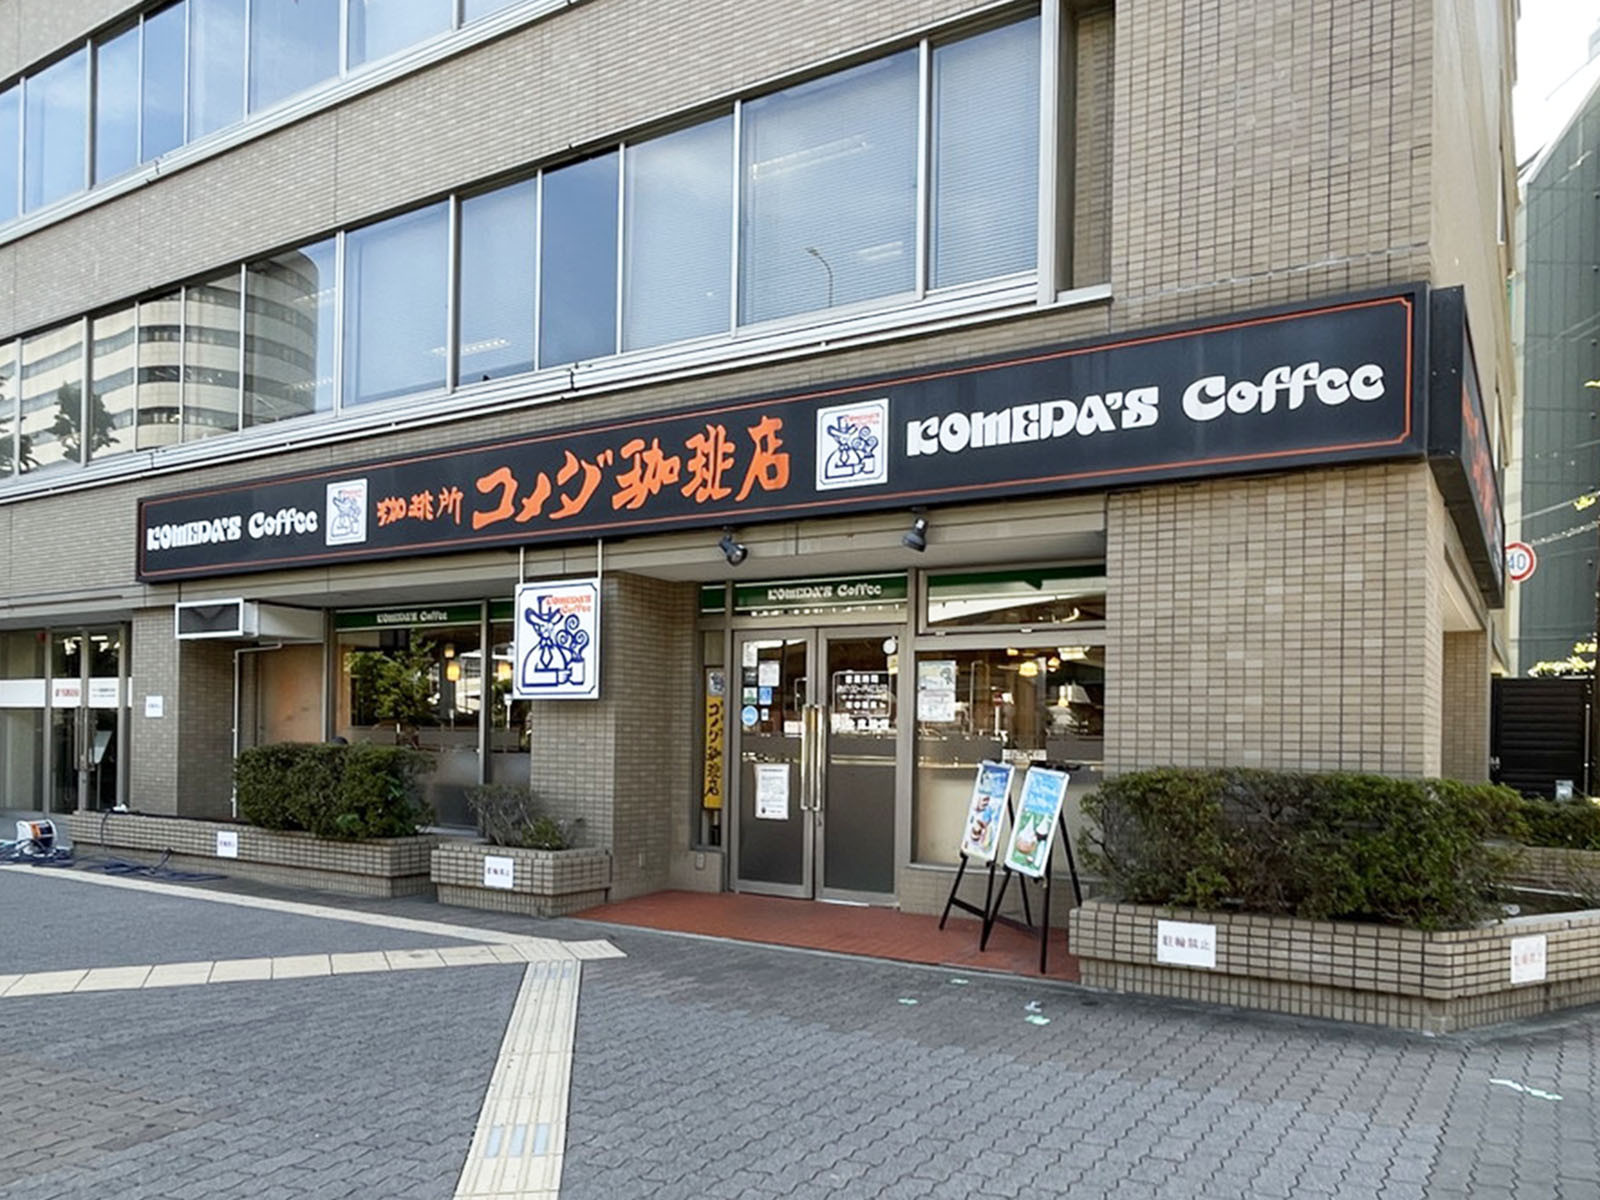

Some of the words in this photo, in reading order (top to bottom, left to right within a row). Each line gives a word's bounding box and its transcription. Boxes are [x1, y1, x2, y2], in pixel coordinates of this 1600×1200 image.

[906, 387, 1159, 457] KOMEDA'S
[1182, 362, 1386, 421] Coffee
[472, 415, 791, 530] コメダ珈琲店
[376, 486, 464, 527] 珈琲所
[146, 515, 242, 551] KOMEDA'S
[248, 507, 318, 539] Coffee
[767, 585, 833, 600] KOMEDA'S
[837, 583, 882, 597] Coffee
